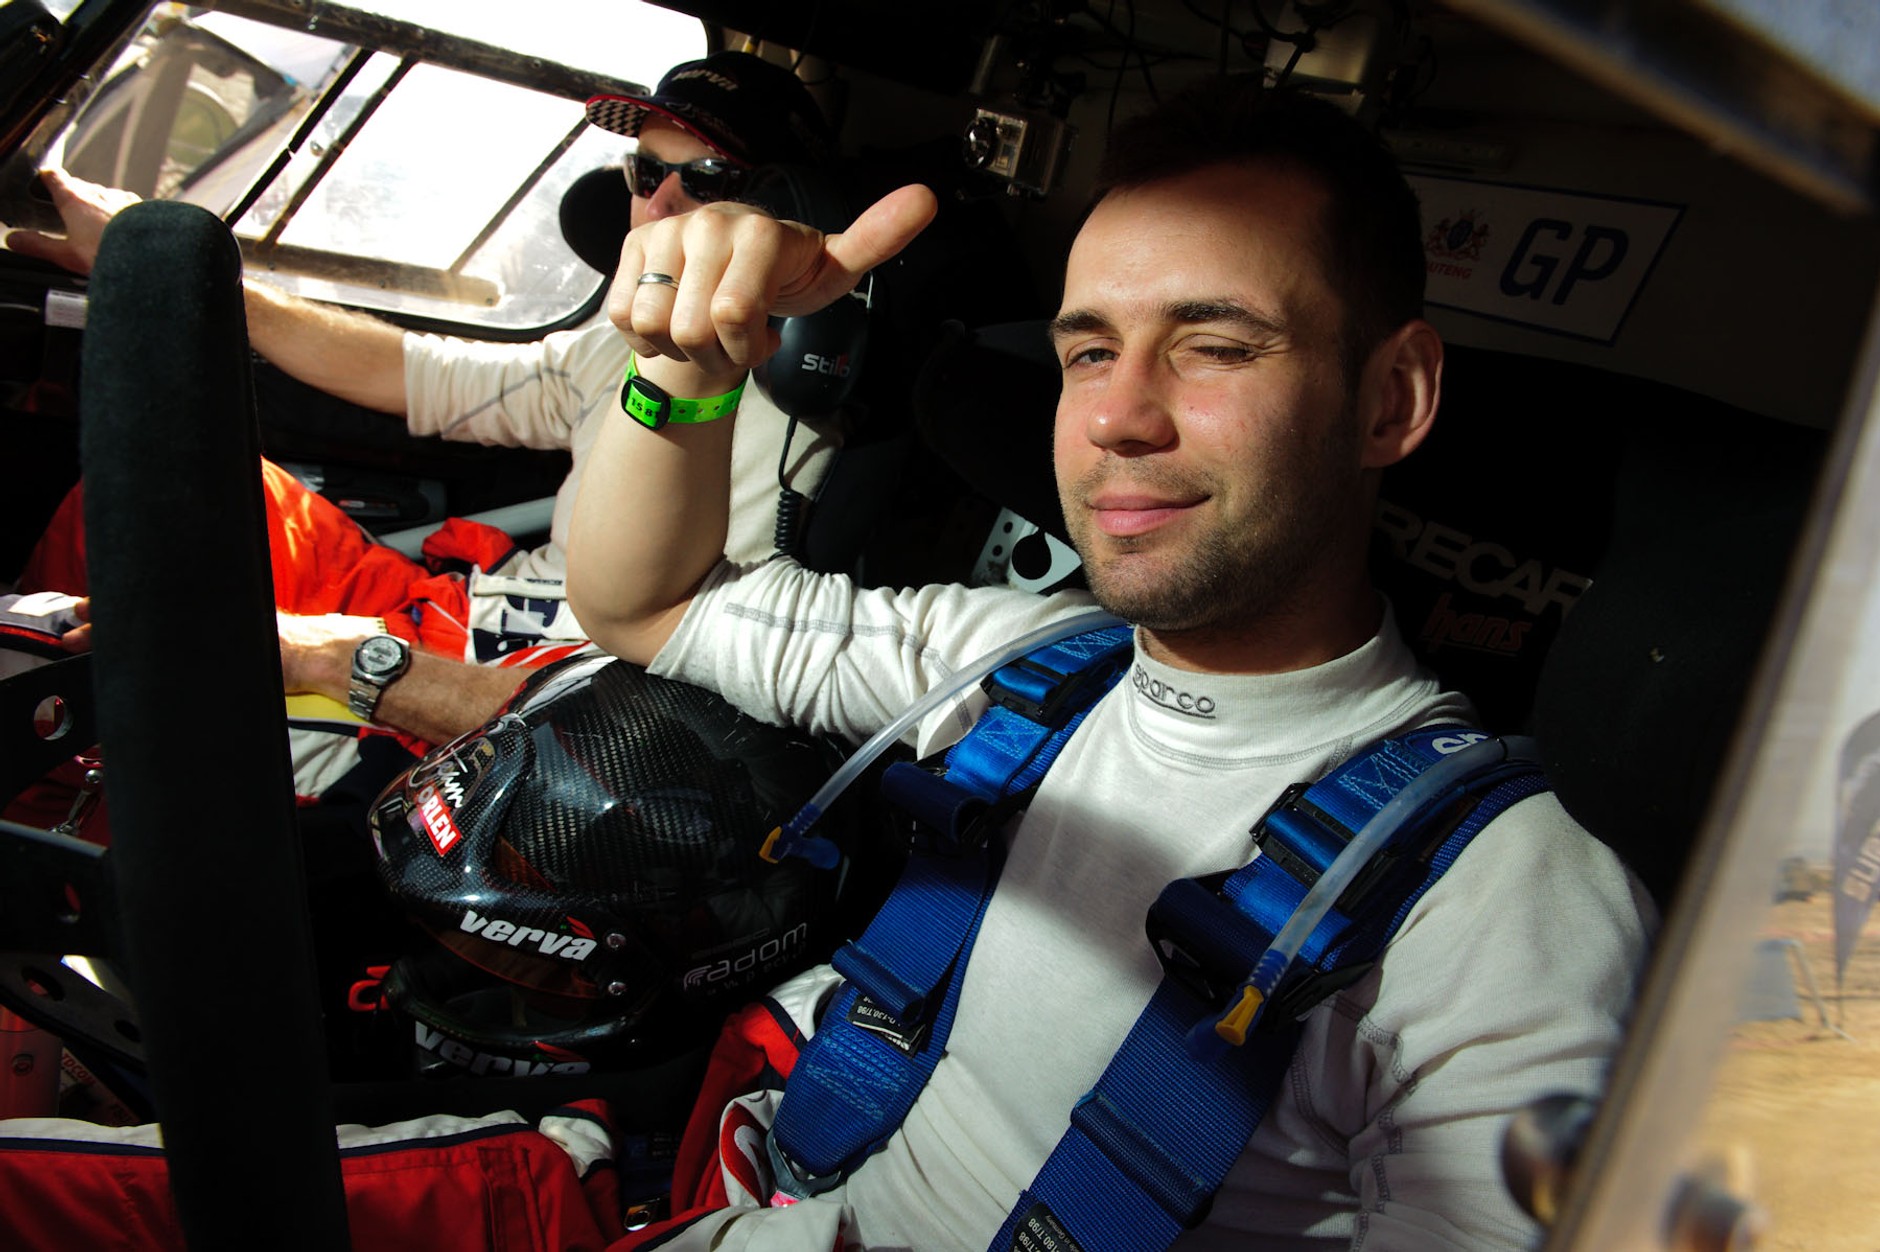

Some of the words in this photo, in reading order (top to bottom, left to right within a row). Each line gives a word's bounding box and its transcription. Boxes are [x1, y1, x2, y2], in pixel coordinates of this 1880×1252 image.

[1499, 217, 1630, 306] GP
[1132, 663, 1216, 714] sparco
[417, 785, 457, 850] ORLEN
[459, 910, 598, 962] verva
